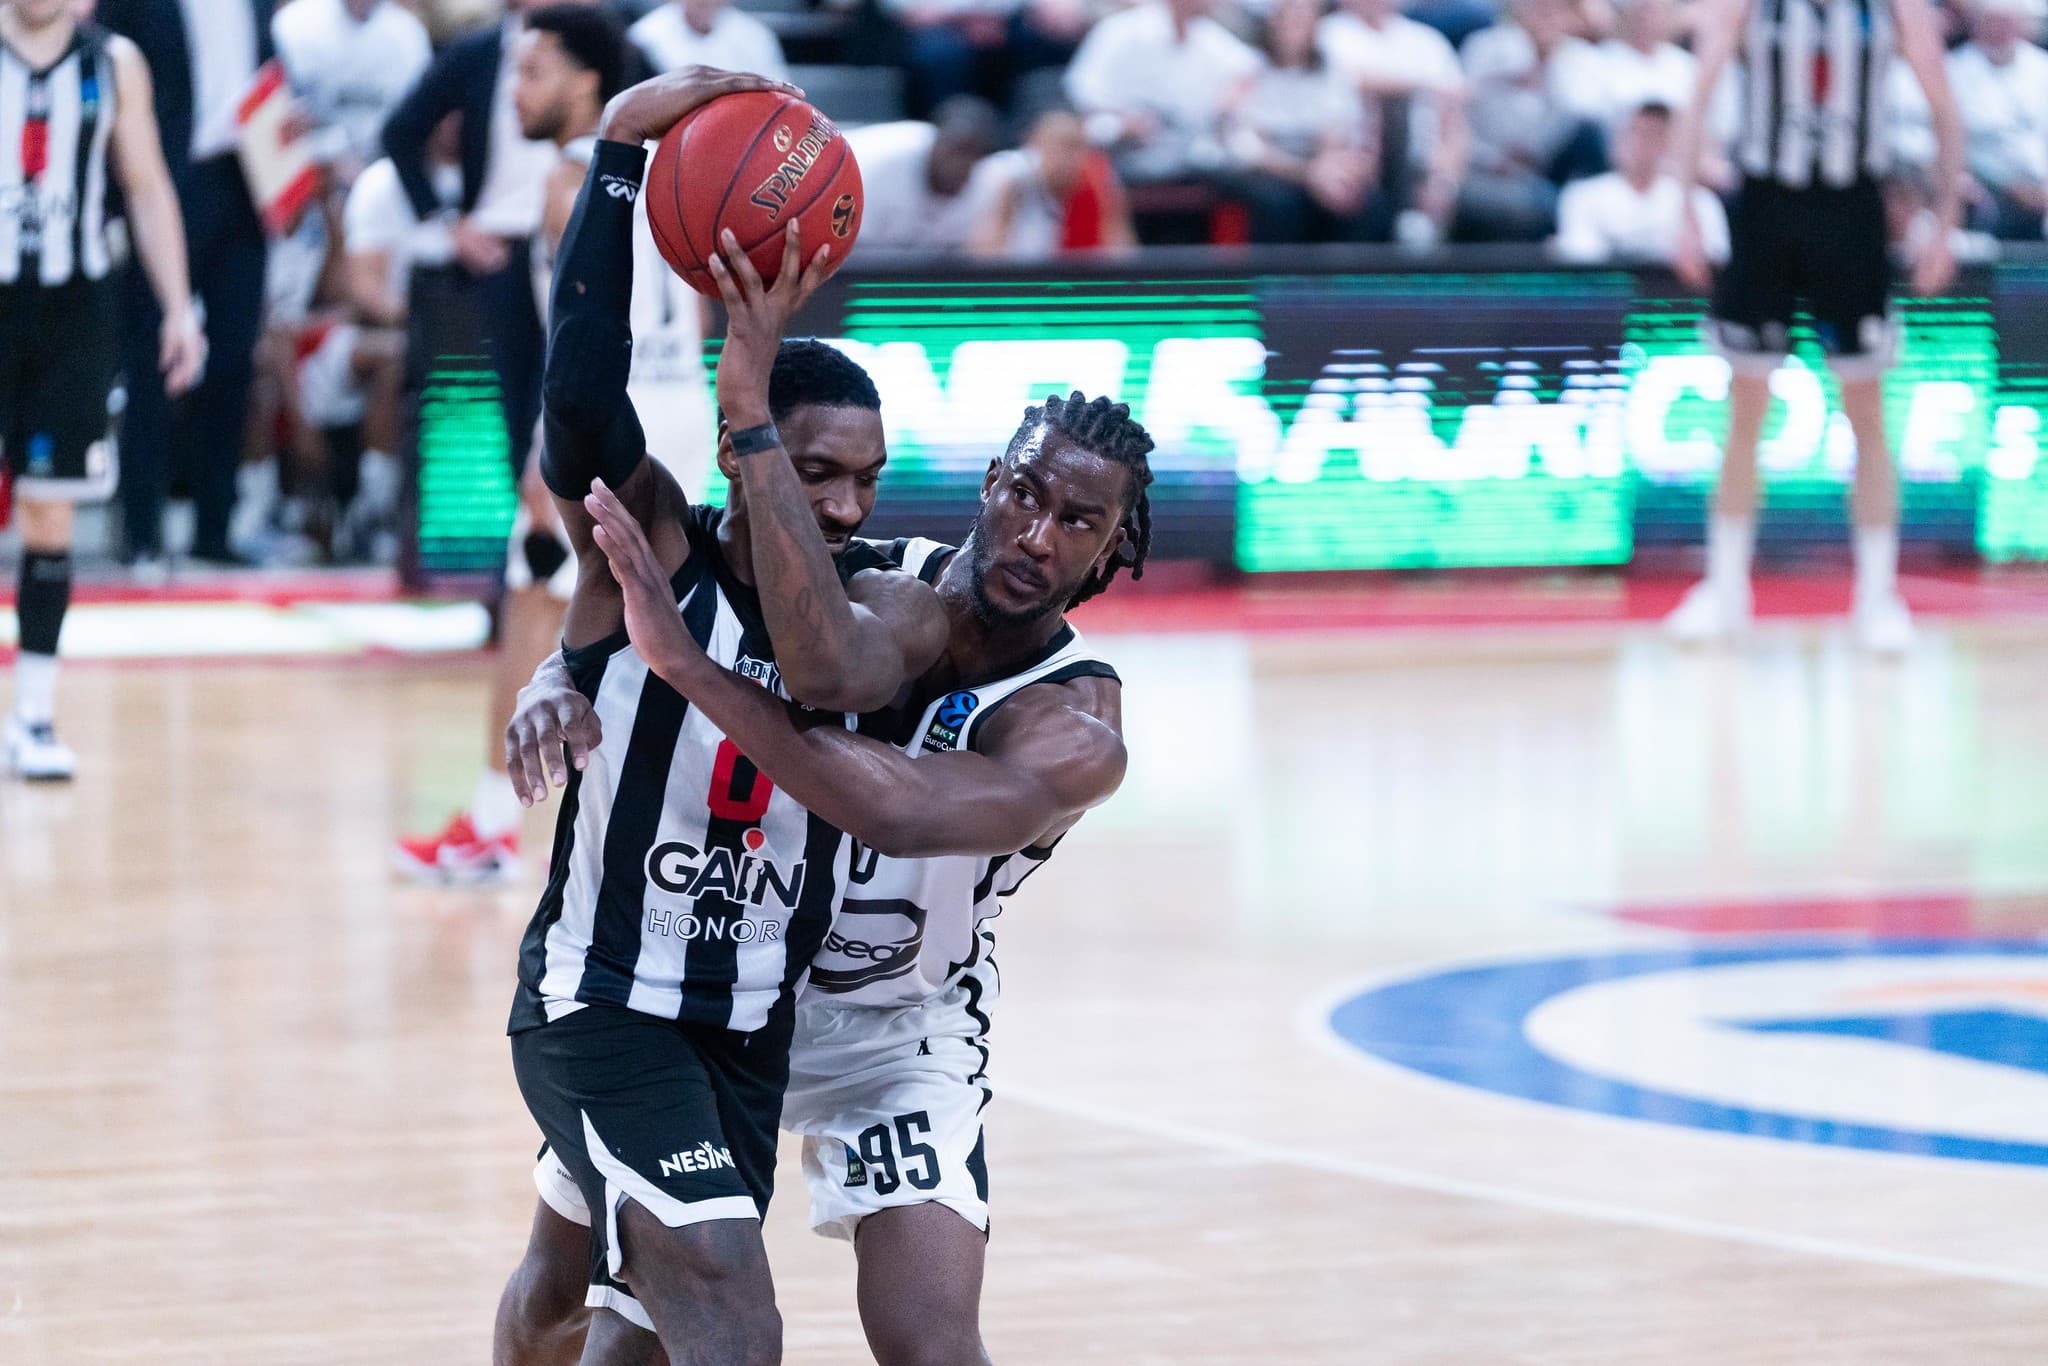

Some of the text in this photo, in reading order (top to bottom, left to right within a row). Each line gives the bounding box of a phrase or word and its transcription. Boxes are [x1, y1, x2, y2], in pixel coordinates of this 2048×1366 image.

[742, 660, 771, 680] BJK
[931, 724, 956, 741] BKT
[644, 830, 807, 909] GAIN
[648, 908, 780, 943] HONOR
[858, 1110, 942, 1196] 95
